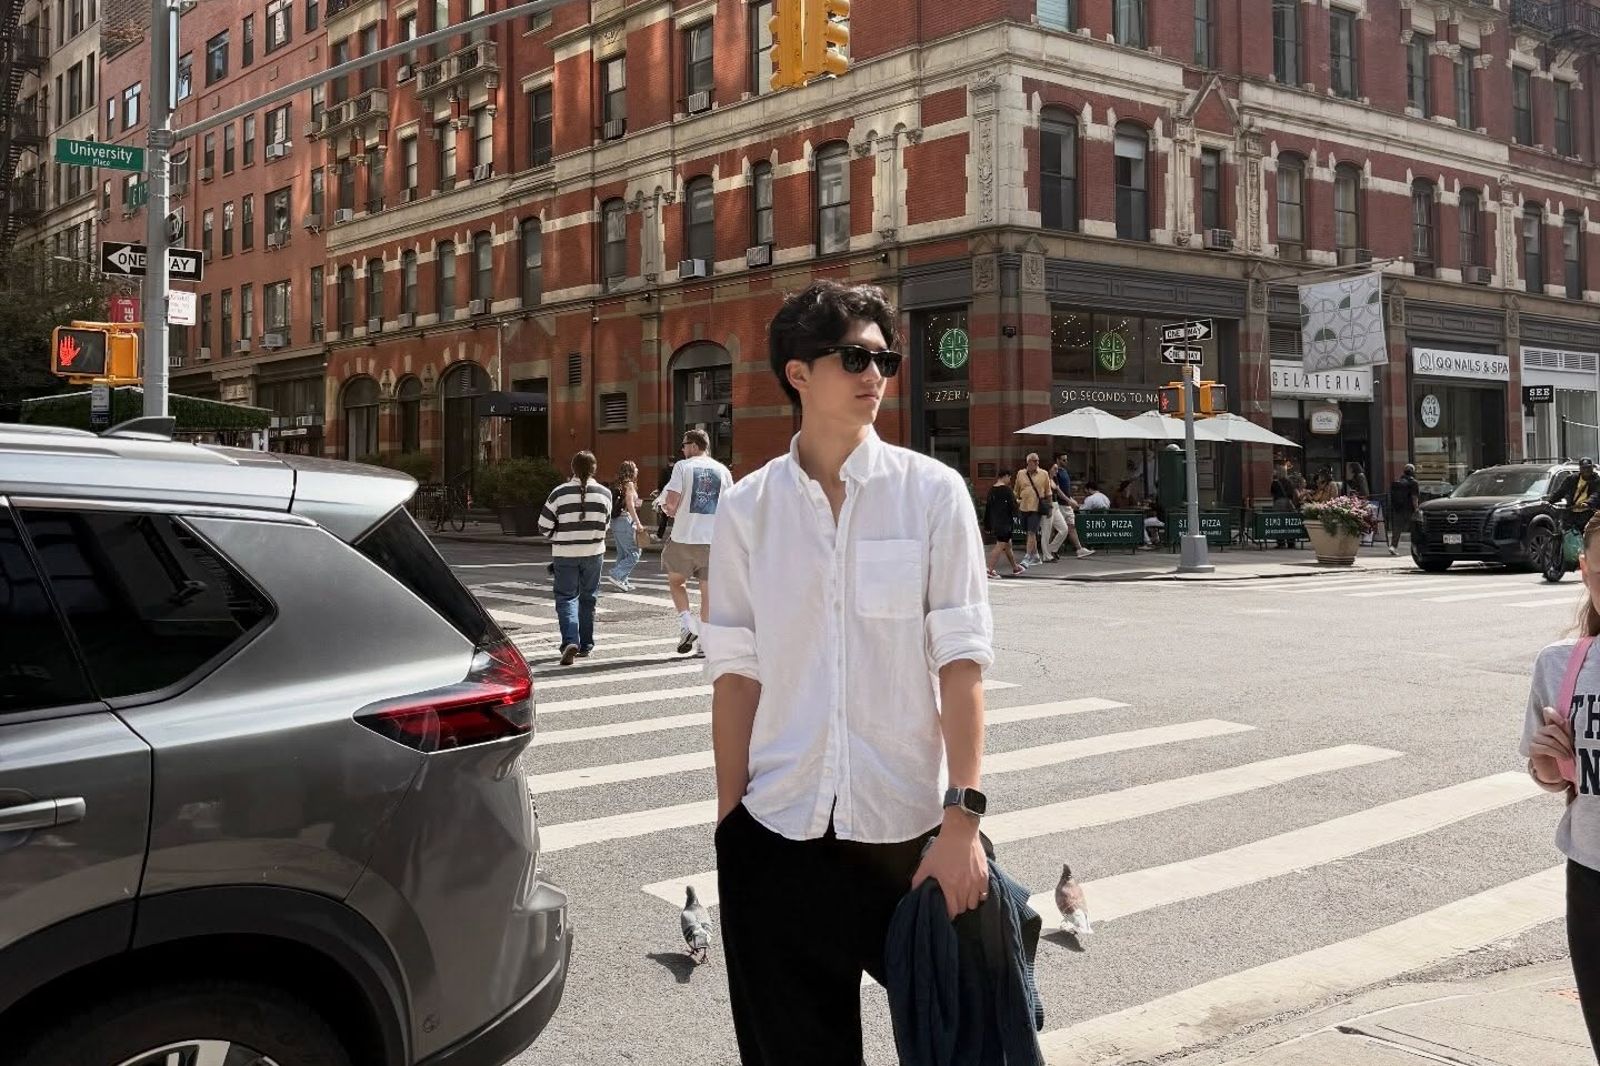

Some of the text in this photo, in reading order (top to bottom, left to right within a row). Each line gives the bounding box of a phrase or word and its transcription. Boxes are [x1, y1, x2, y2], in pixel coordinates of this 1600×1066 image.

[70, 142, 133, 163] University
[92, 158, 111, 167] Place
[118, 252, 190, 271] ONE AY
[1167, 329, 1181, 338] ONE
[1168, 350, 1180, 359] ONE
[1454, 358, 1481, 372] NAILS
[1491, 361, 1509, 374] SPA
[1272, 371, 1361, 391] GELATERIA
[1080, 390, 1127, 402] SECONDS
[1529, 388, 1550, 396] SEE
[1111, 520, 1133, 529] PIZZA
[1201, 519, 1221, 527] PIZZA
[1285, 517, 1302, 526] PIZZA
